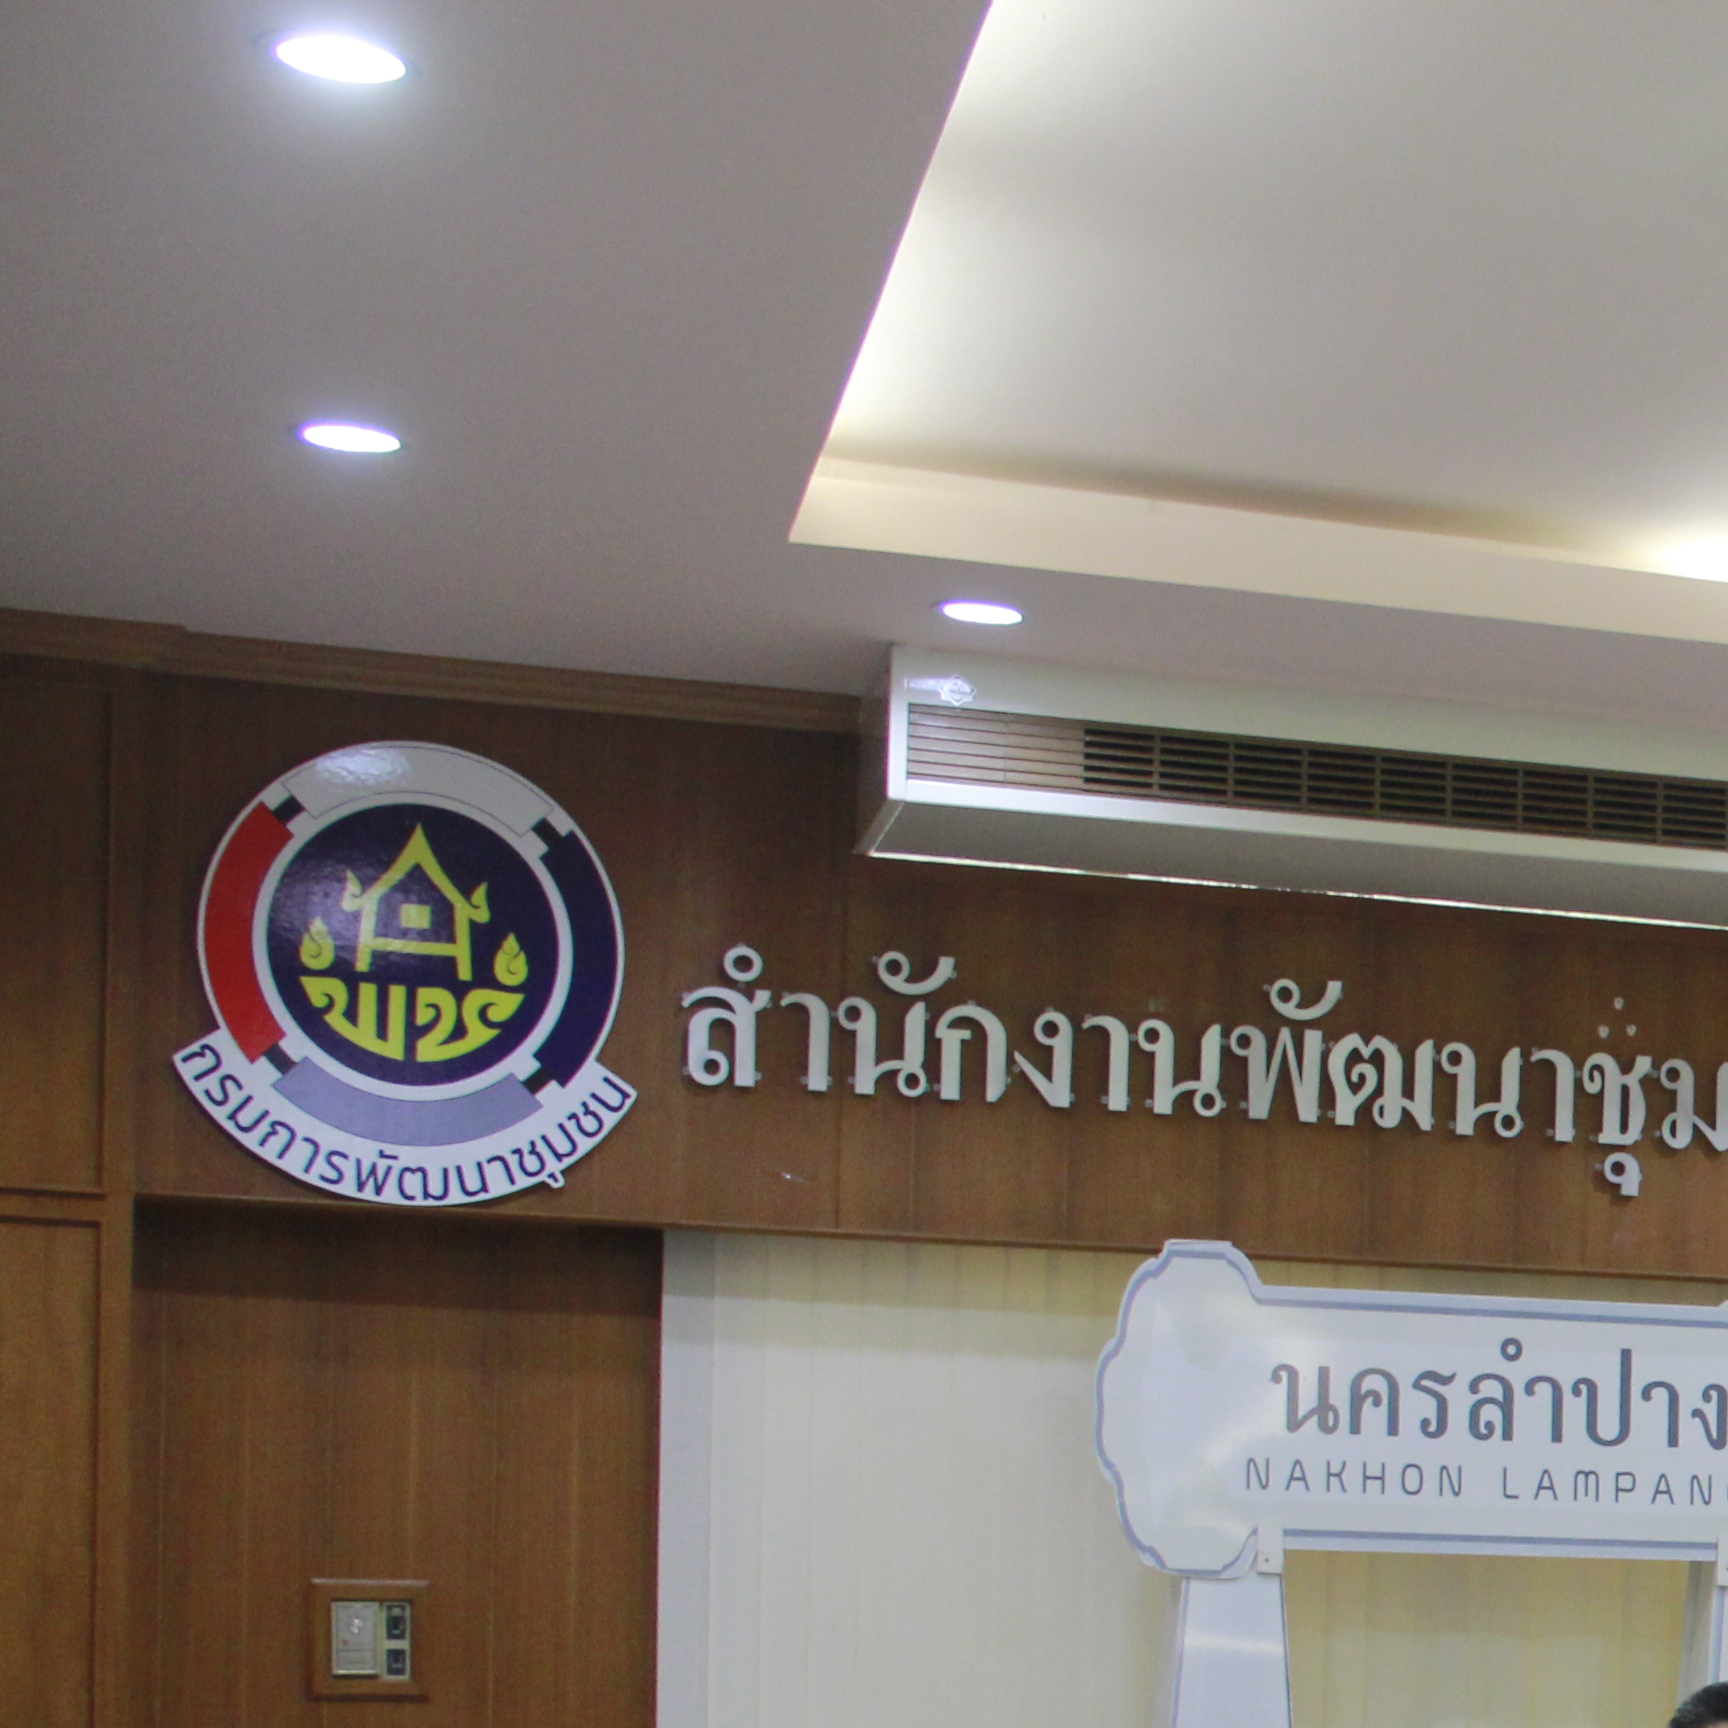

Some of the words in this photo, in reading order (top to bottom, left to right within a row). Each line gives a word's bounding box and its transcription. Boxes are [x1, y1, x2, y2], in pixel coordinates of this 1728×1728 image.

[180, 1042, 633, 1201] กรมการพัฒนาชุมชน
[1245, 1456, 1464, 1498] NAKHON
